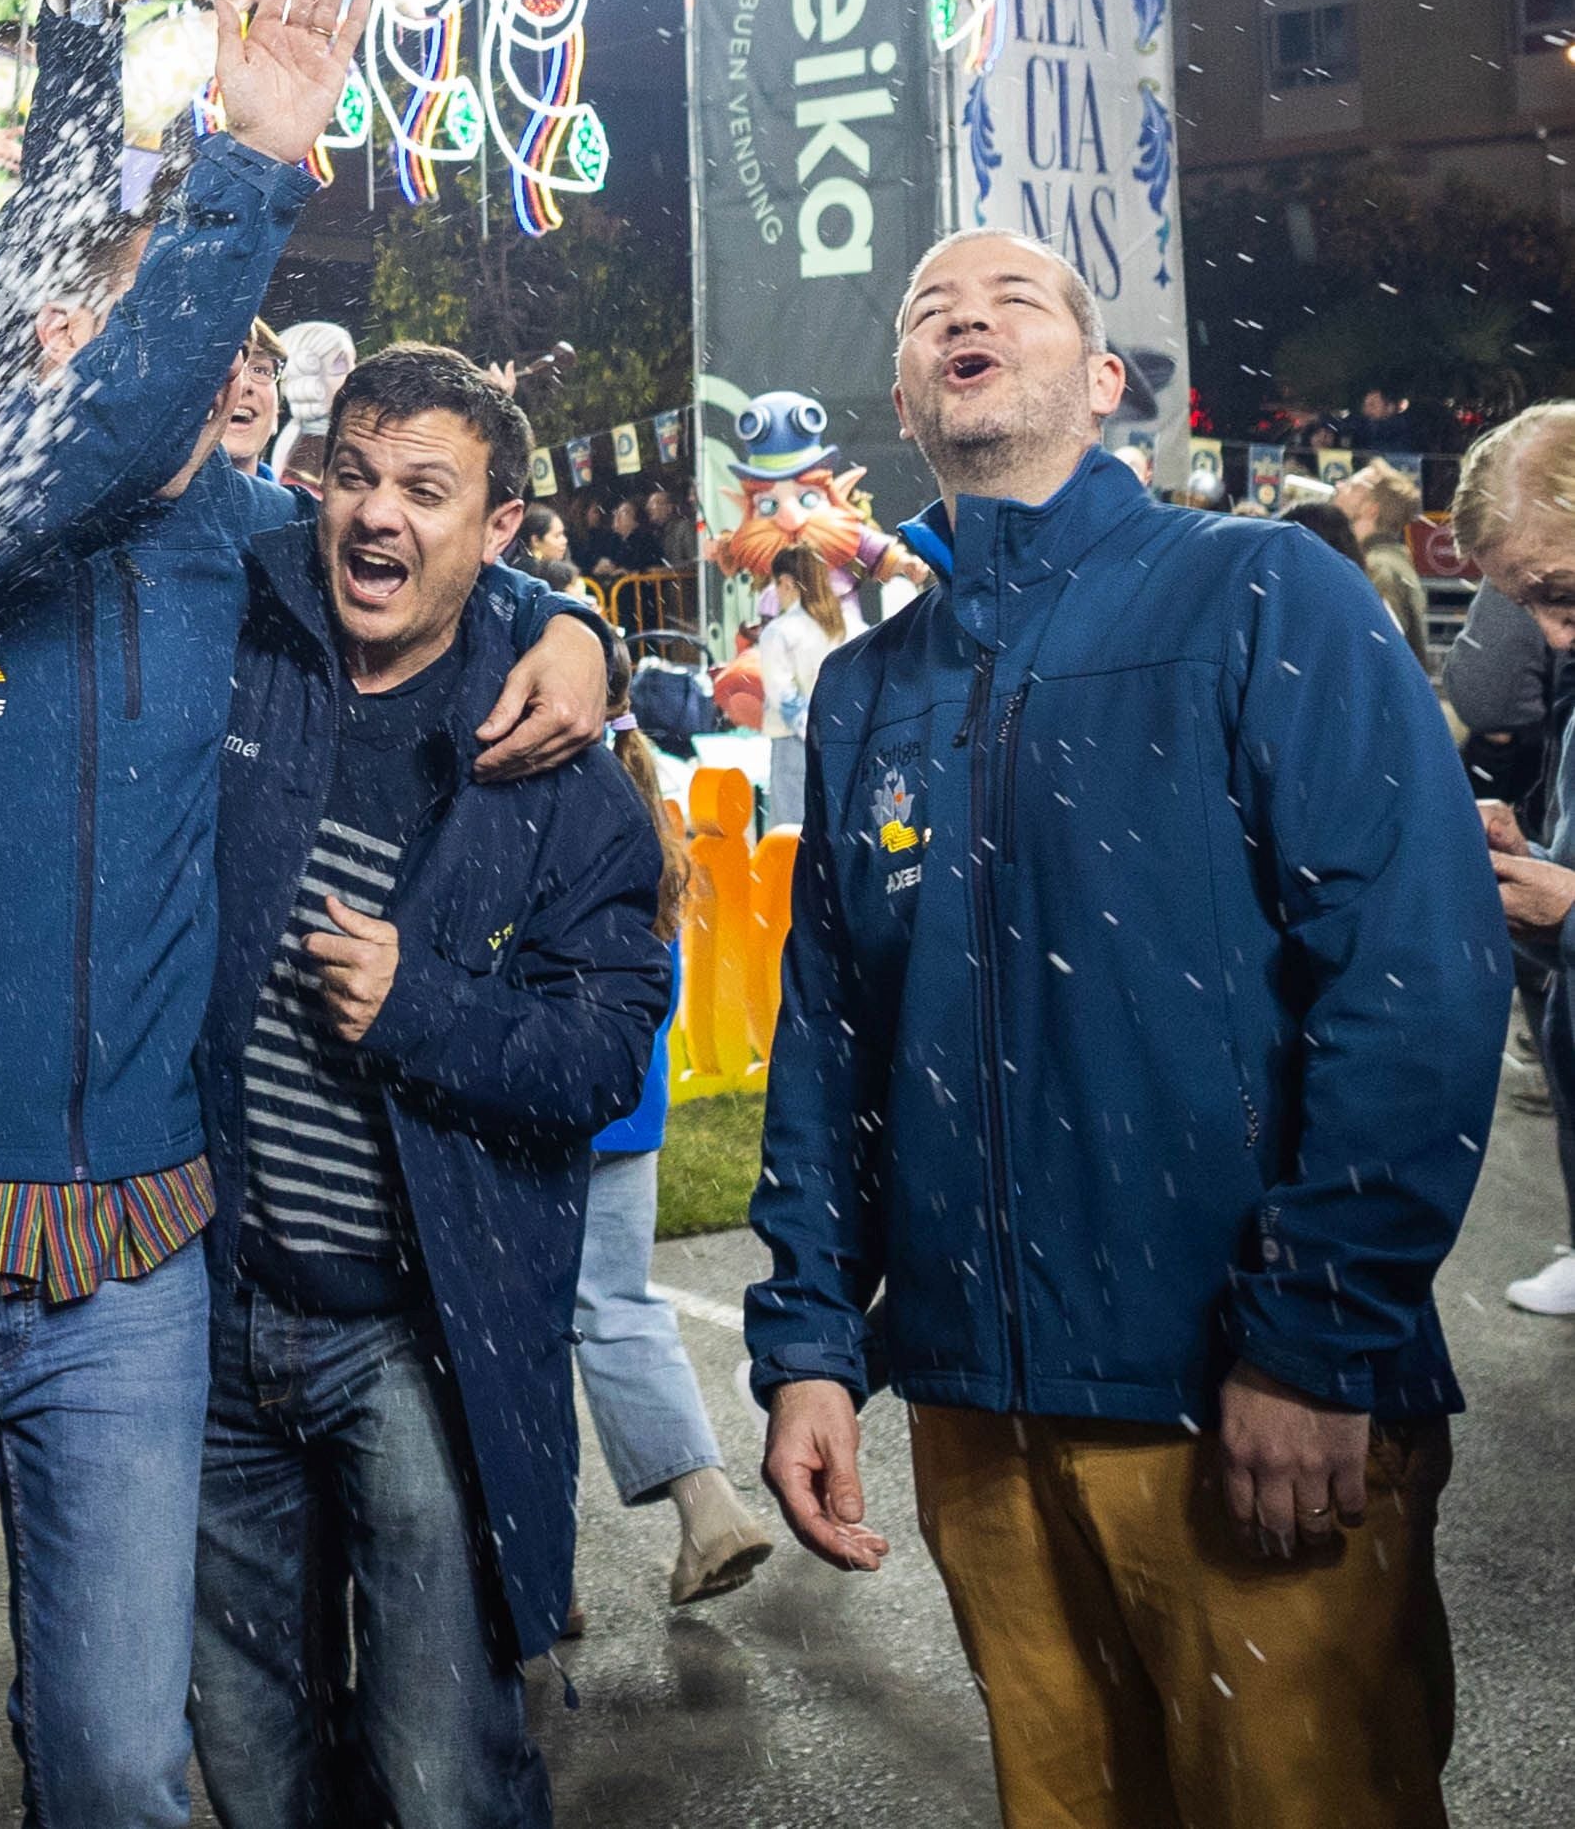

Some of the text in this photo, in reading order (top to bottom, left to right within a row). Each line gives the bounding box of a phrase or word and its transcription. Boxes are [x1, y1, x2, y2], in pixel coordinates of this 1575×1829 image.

[727, 90, 784, 245] VENDING
[1025, 54, 1109, 173] CIA
[1019, 178, 1122, 302] NAS
